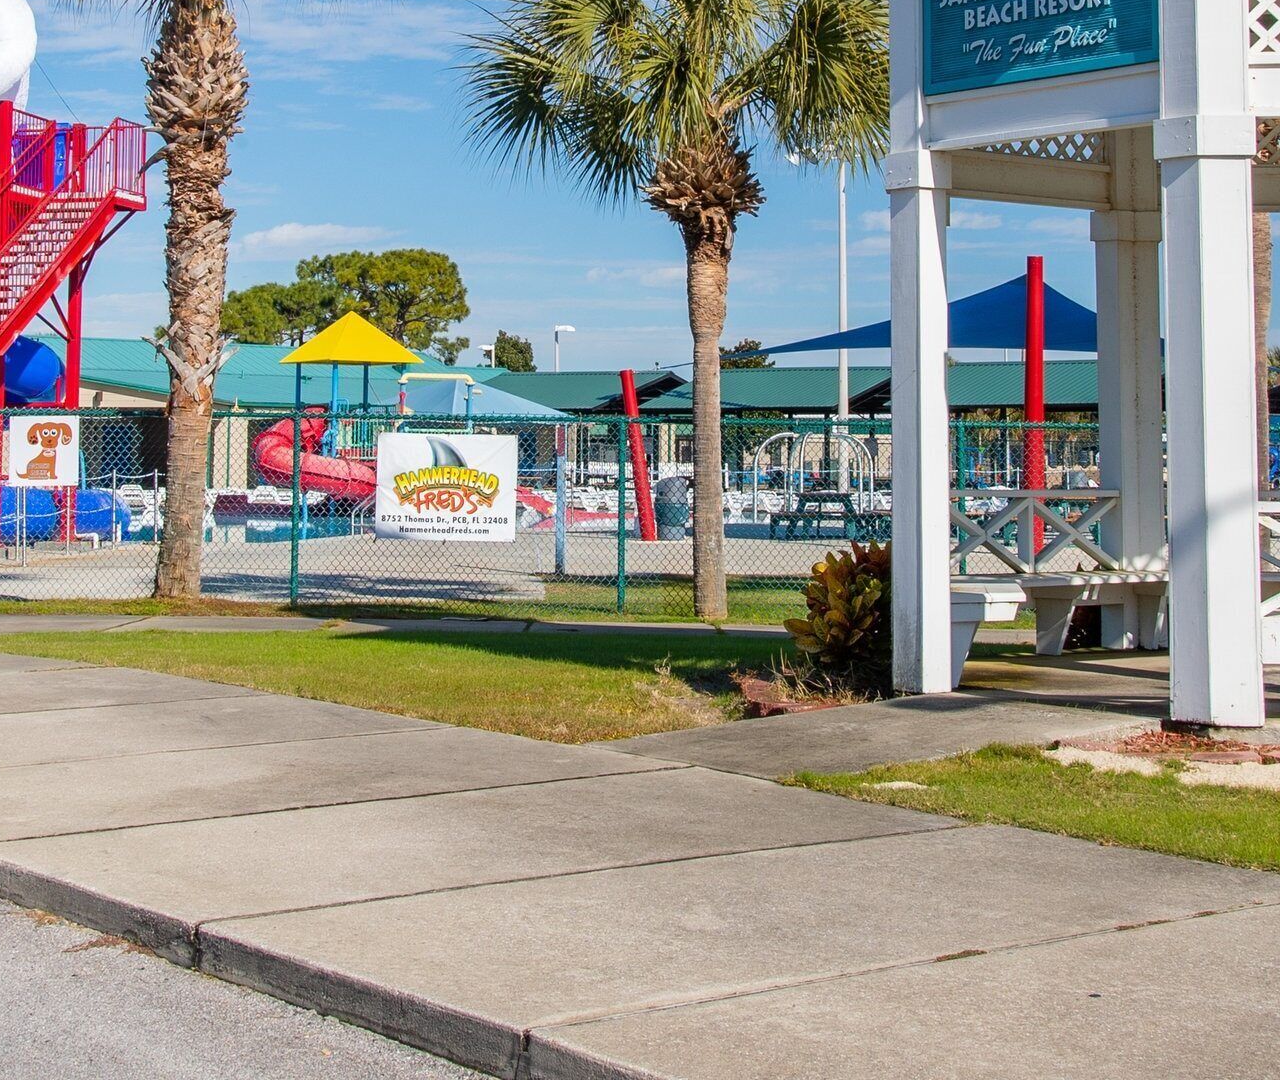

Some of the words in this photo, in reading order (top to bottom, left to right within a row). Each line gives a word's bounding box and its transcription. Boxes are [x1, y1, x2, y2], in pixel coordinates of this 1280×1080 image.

[964, 0, 1028, 30] BEACH
[963, 38, 1002, 65] "The
[1008, 33, 1046, 62] Fun
[1053, 18, 1117, 53] Place"
[394, 466, 499, 497] HAMMERHEAD
[414, 486, 478, 515] FRED'S
[381, 514, 402, 522] 8752
[404, 515, 434, 523] Thomas
[437, 516, 450, 525] Dr.,
[452, 516, 470, 525] PCB,
[472, 516, 480, 524] FL
[483, 516, 508, 525] 32408
[399, 525, 489, 535] HammerheadFreds.com
